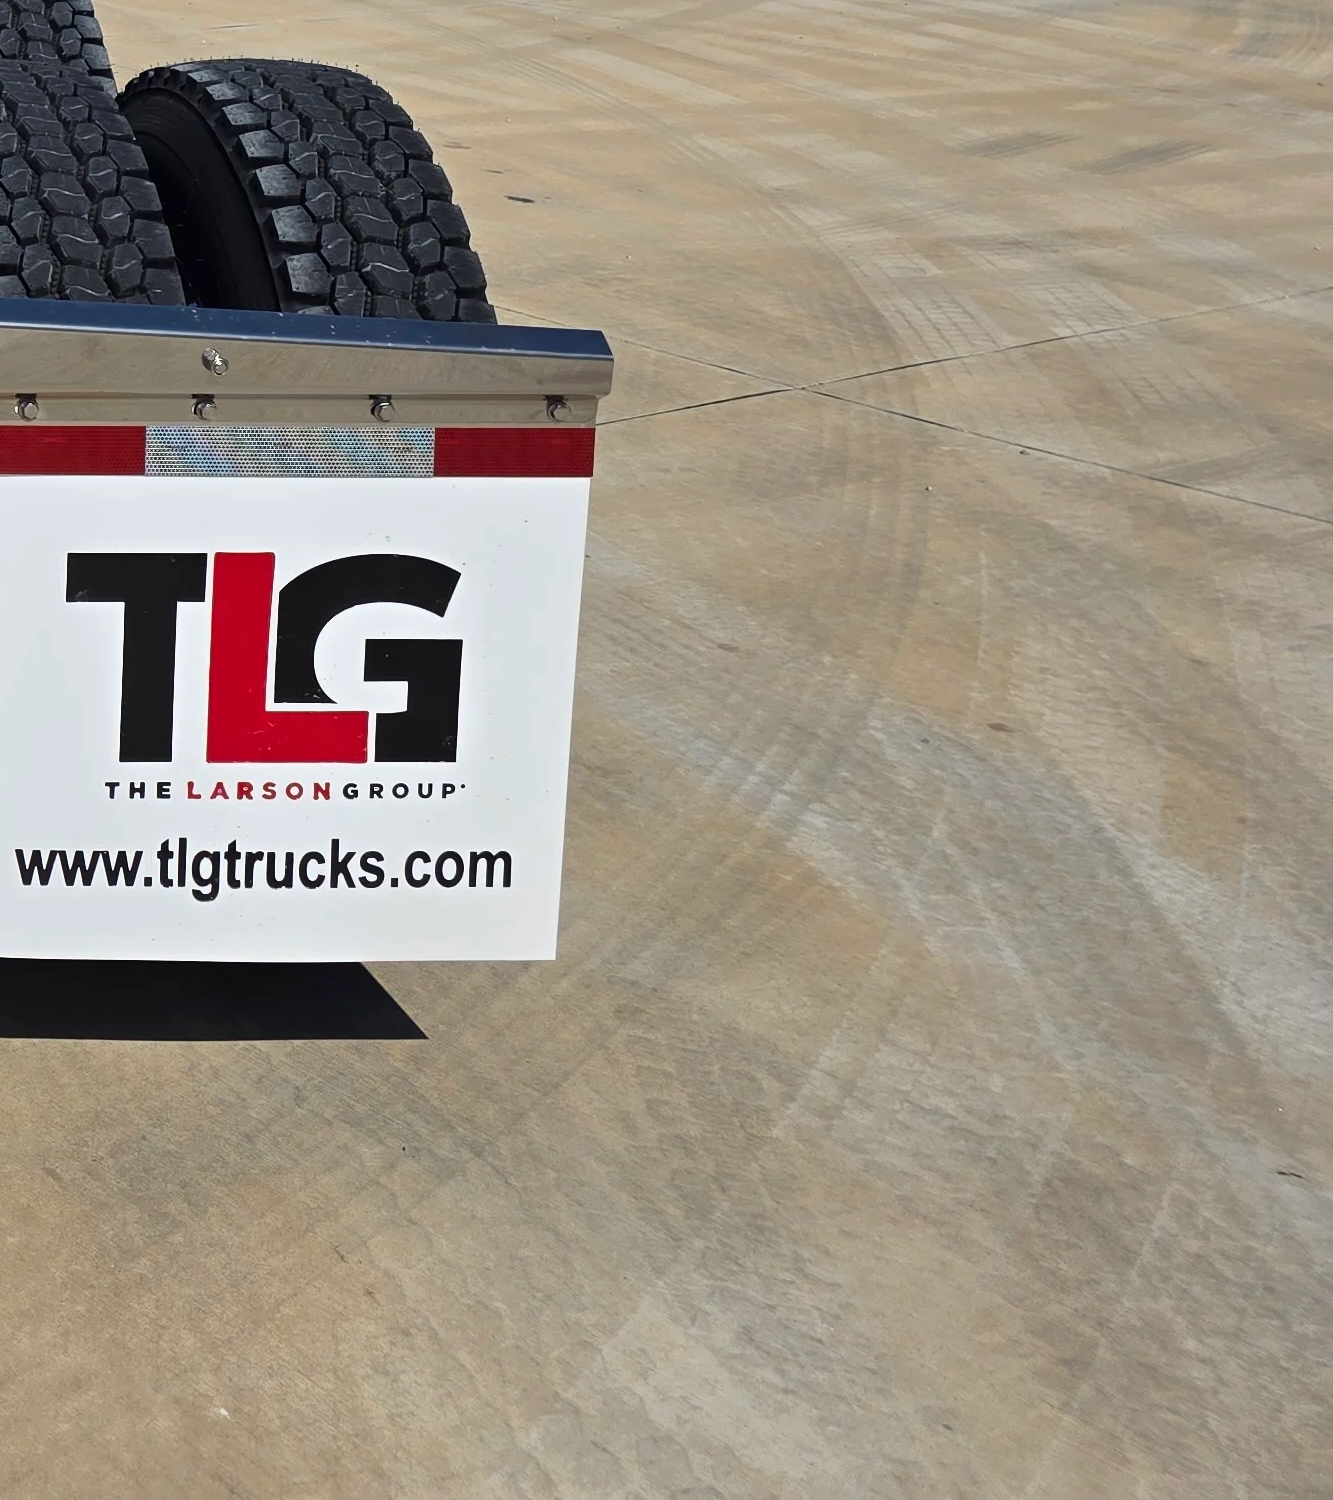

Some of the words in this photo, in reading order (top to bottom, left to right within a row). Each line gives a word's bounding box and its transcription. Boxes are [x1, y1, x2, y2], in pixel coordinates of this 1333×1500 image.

[66, 552, 463, 763] TLG
[105, 782, 171, 799] THE
[188, 781, 330, 800] LARSON
[343, 782, 455, 799] GROUP
[15, 838, 511, 902] www.tlgtrucks.com
